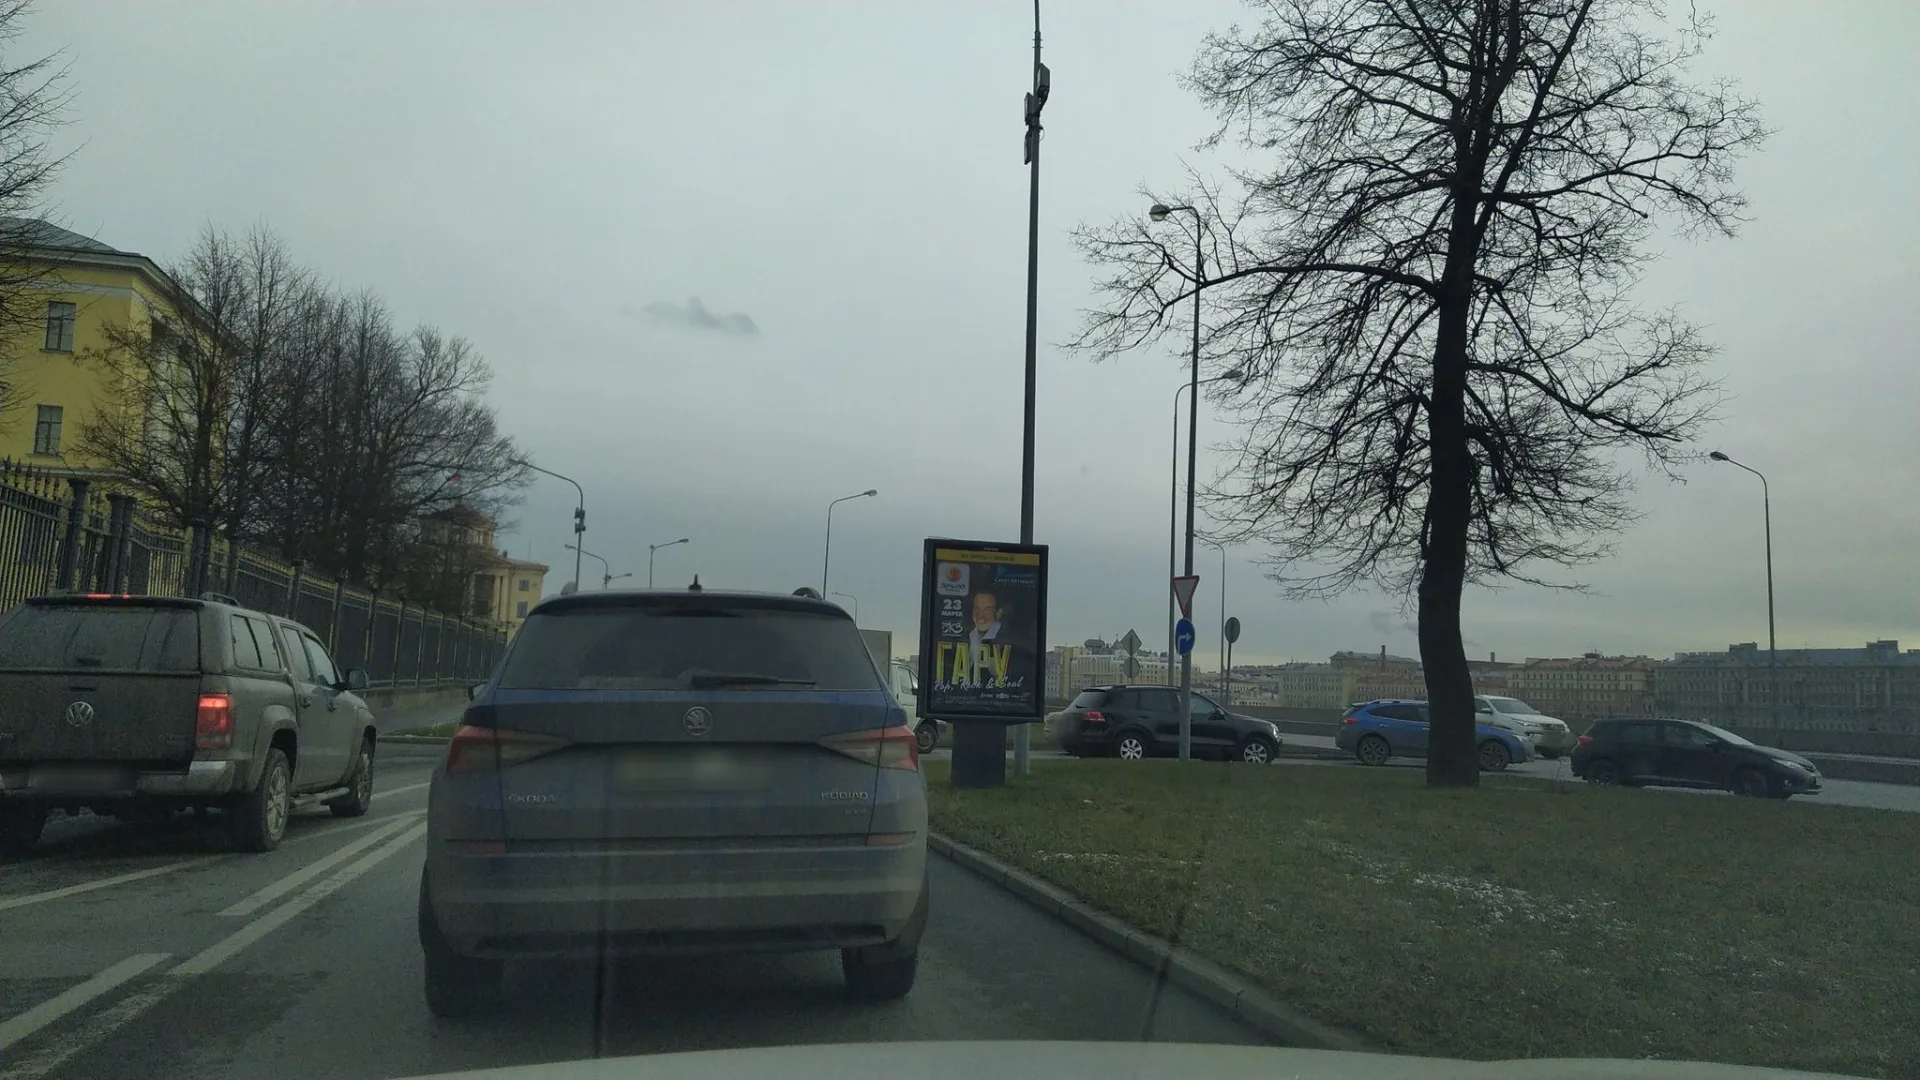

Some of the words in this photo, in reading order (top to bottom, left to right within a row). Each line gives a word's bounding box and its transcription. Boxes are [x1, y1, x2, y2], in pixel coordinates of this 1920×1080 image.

[943, 599, 962, 610] 23
[936, 641, 1012, 688] ГАРУ
[959, 678, 982, 691] Rock
[986, 678, 995, 689] &
[1000, 676, 1024, 688] Soul
